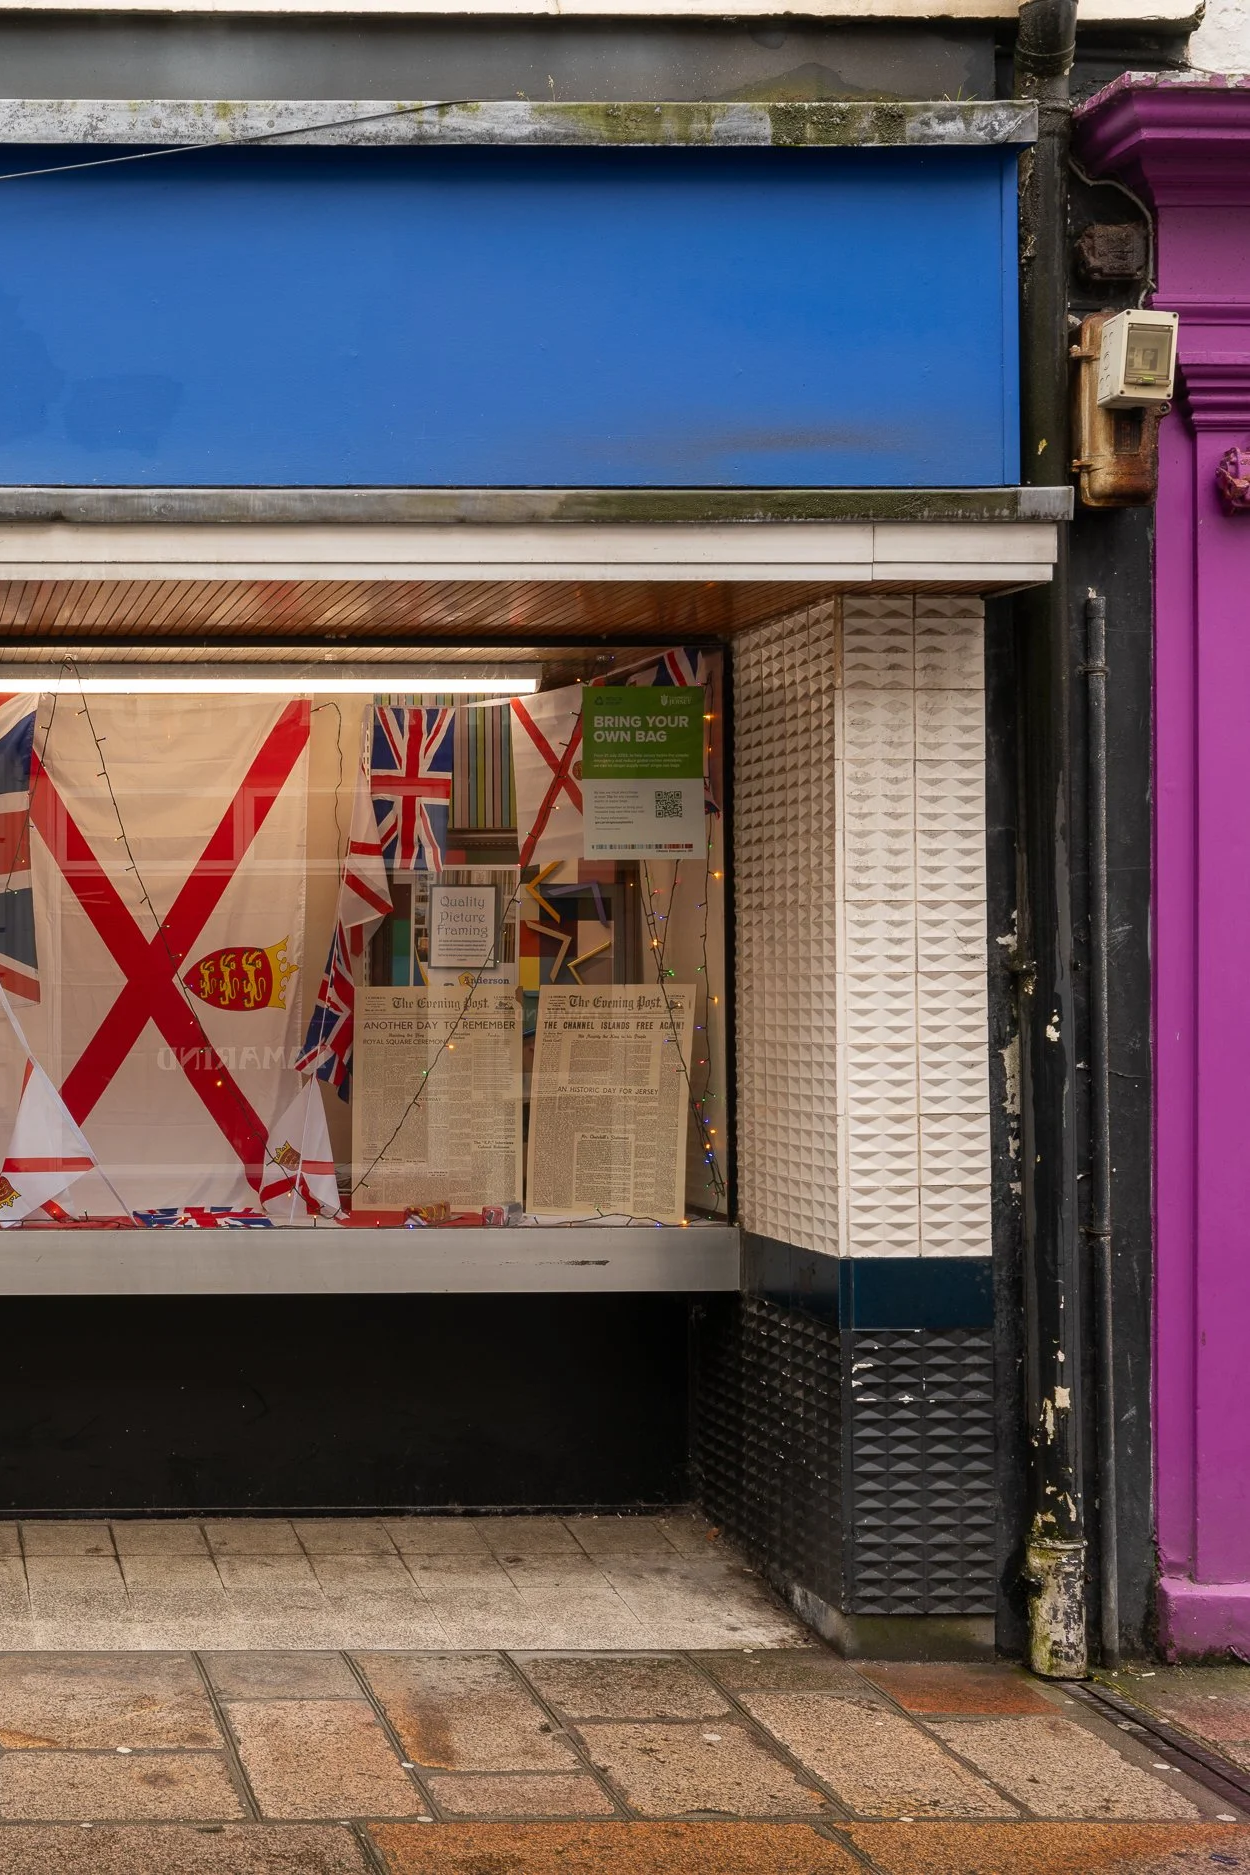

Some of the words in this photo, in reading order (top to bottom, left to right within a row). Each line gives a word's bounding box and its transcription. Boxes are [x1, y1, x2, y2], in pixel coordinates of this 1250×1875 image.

[593, 715, 642, 728] BRING
[645, 715, 689, 728] YOUR
[593, 730, 631, 743] OWN
[635, 730, 668, 743] BAG
[440, 895, 486, 910] Quality
[439, 911, 486, 924] Picture
[437, 924, 489, 939] Framing
[463, 976, 510, 985] Anderson
[392, 996, 414, 1009] The
[417, 996, 461, 1011] Evening
[568, 994, 590, 1008] The
[593, 994, 635, 1011] Evening
[363, 1021, 413, 1030] ANOTHER
[416, 1021, 438, 1030] DAY
[444, 1021, 459, 1030] TO
[462, 1021, 516, 1030] REMEMBER
[543, 1021, 558, 1030] THE
[563, 1021, 595, 1030] CHANNEL
[600, 1021, 630, 1030] ISLANDS
[636, 1021, 654, 1030] FREE
[570, 1086, 601, 1094] HISTORIC
[619, 1087, 633, 1095] FOR
